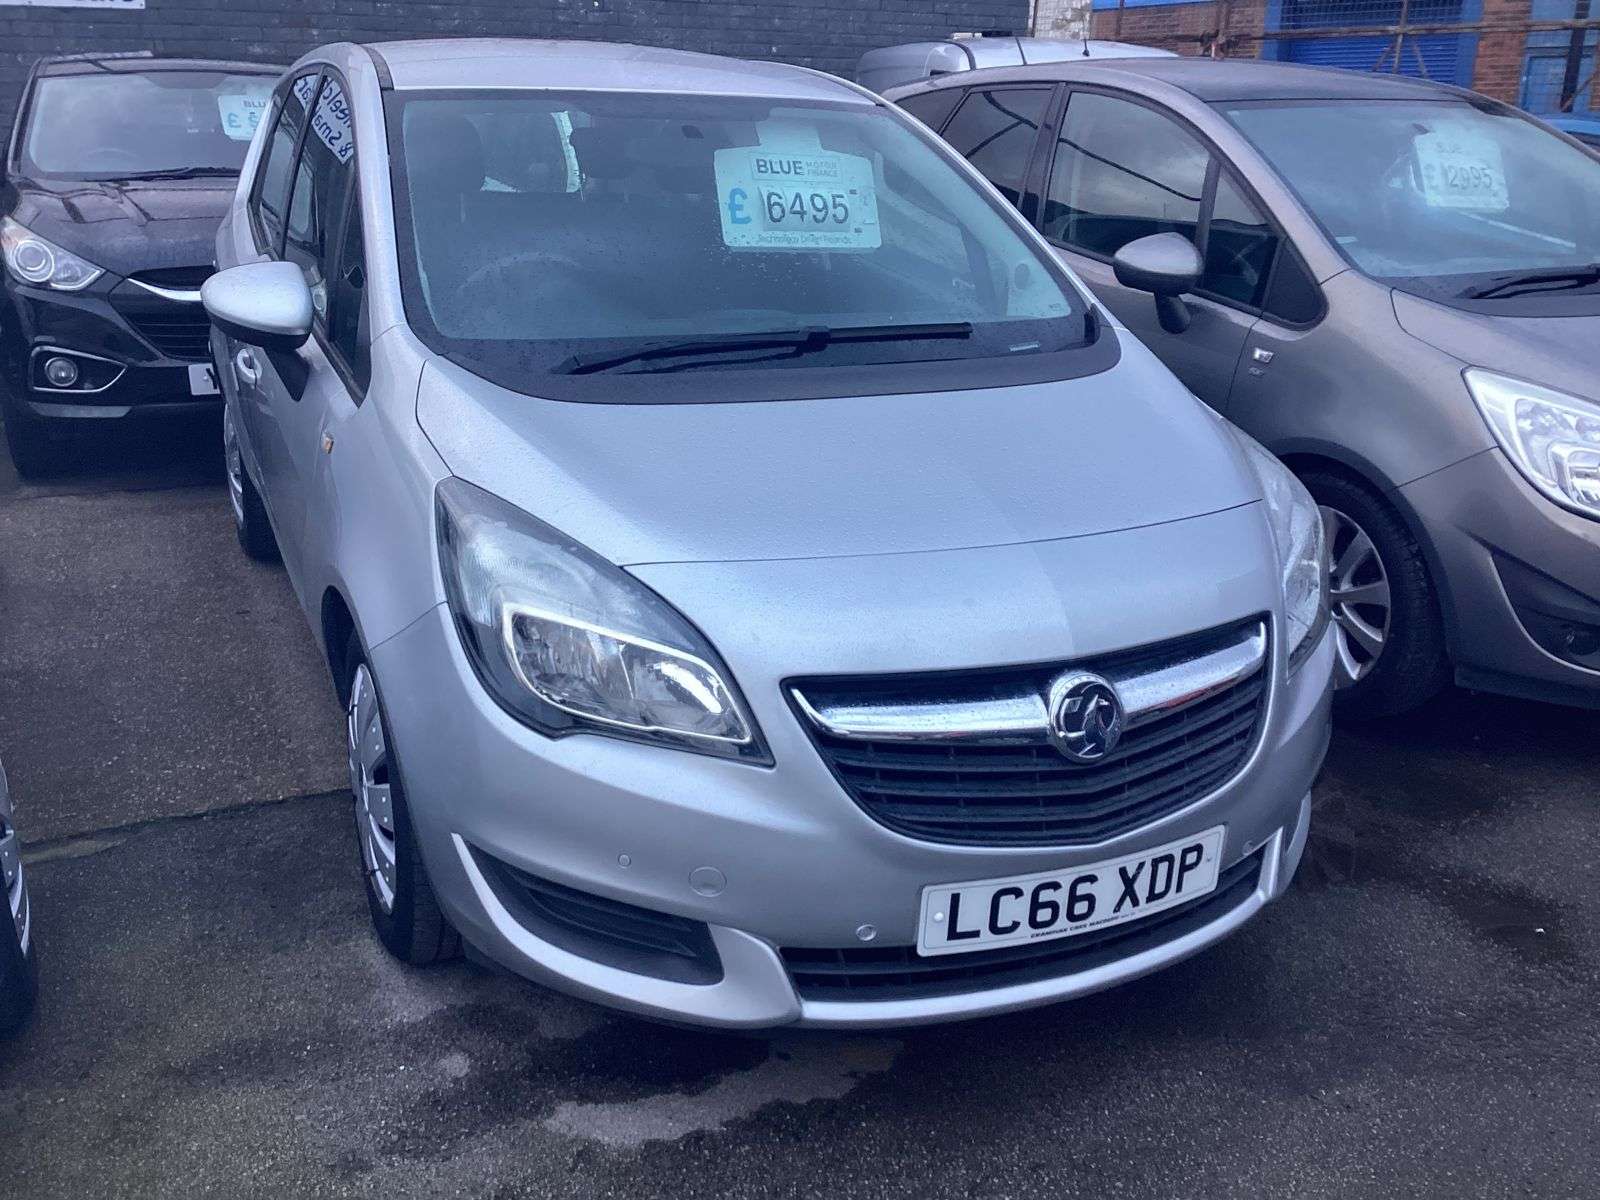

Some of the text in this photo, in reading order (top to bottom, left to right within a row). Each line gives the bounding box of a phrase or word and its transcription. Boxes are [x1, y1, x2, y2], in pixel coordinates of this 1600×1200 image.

[756, 158, 804, 176] BLUE
[728, 187, 849, 225] £ 6495
[946, 843, 1205, 941] LC66 XDP
